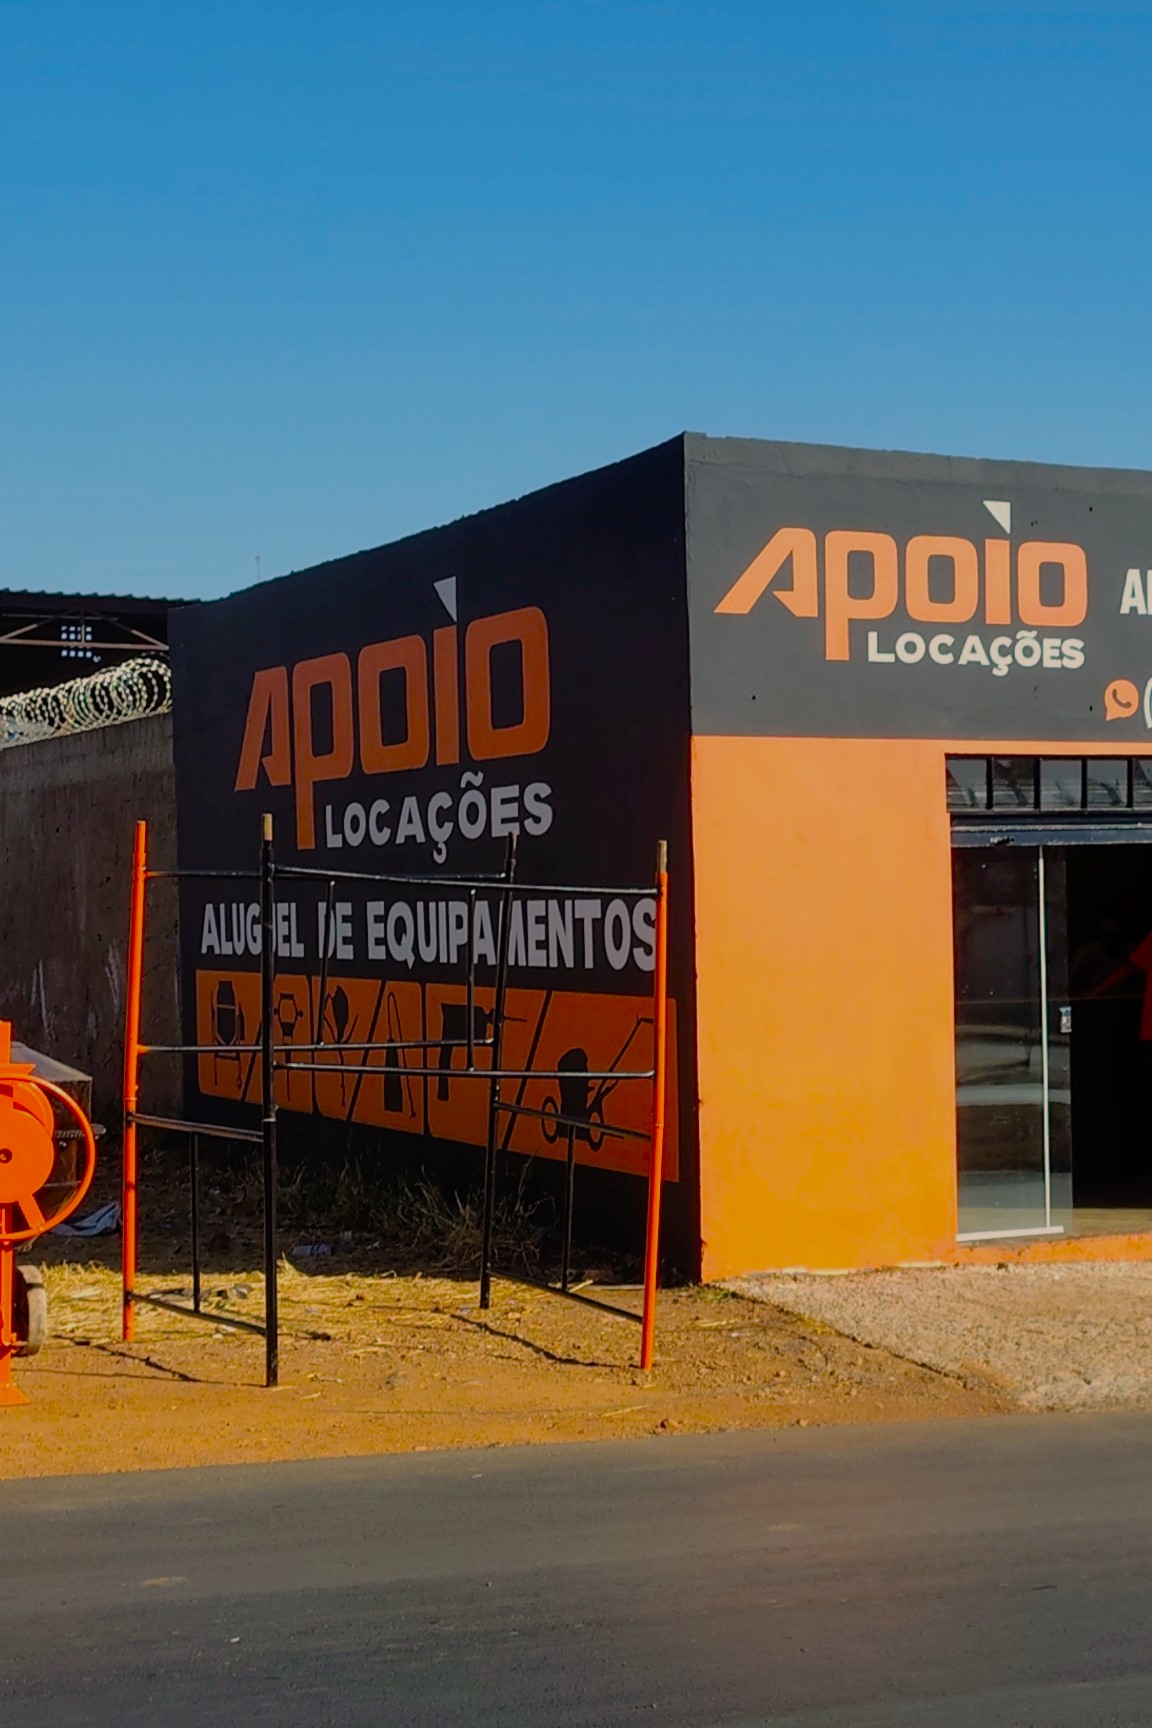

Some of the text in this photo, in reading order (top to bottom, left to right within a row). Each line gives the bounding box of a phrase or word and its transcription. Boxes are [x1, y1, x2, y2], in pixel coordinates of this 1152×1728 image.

[867, 630, 1085, 677] LOCAÇÕES
[325, 771, 553, 863] LOCAÇÕES
[201, 902, 305, 958] ALUGEL
